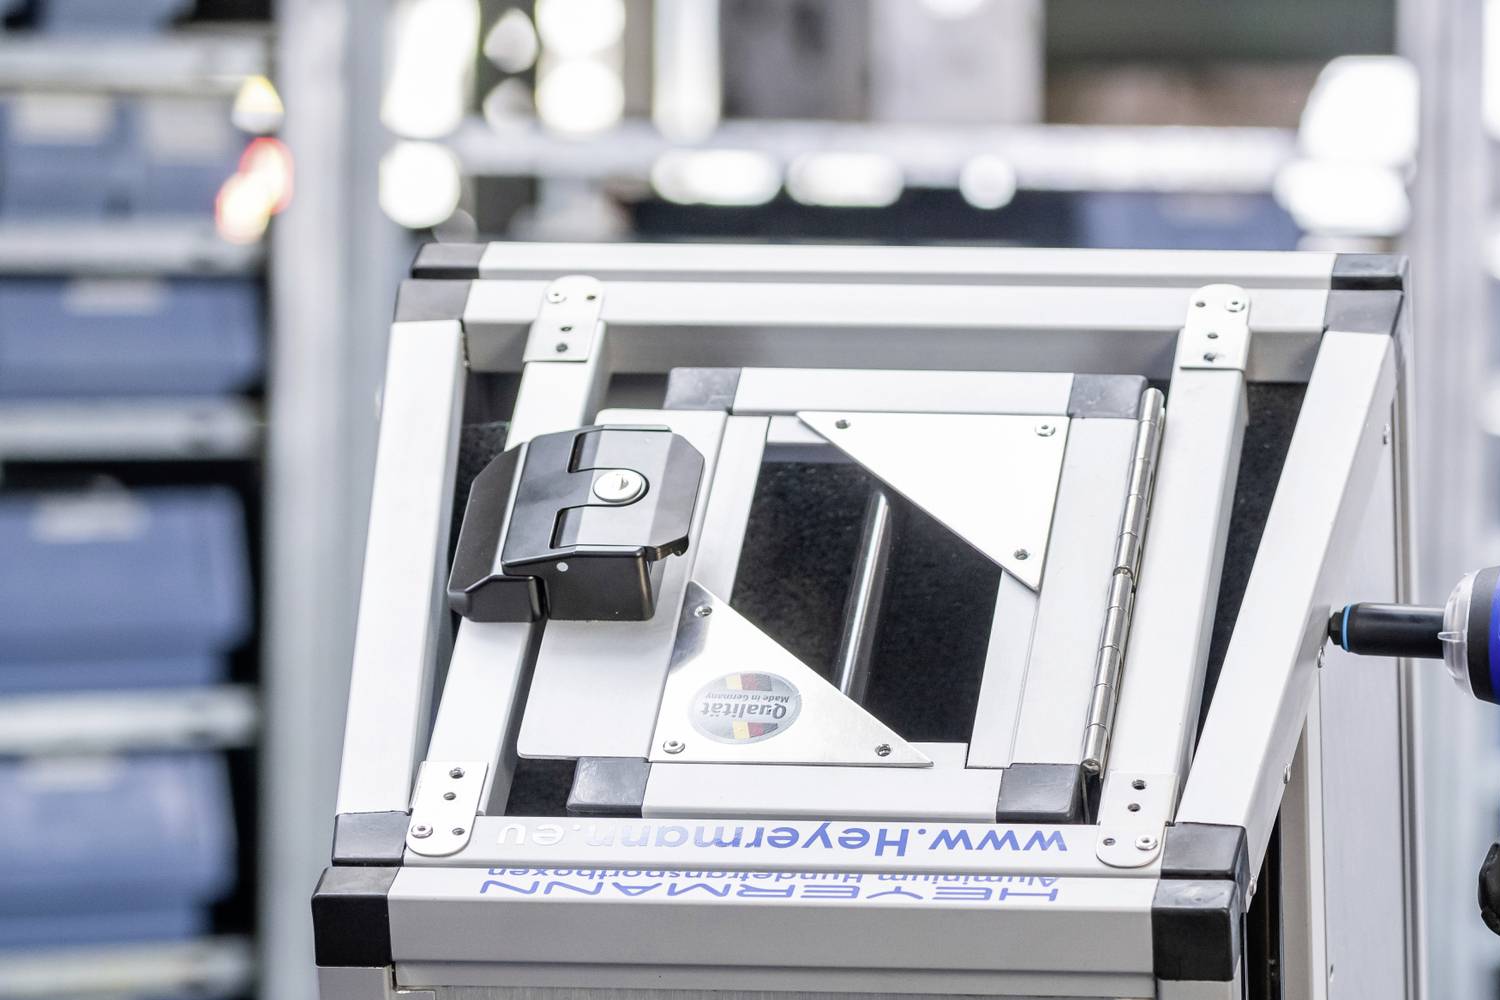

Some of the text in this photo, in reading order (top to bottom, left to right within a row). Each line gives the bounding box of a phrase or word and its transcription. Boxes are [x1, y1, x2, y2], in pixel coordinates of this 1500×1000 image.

[762, 695, 790, 704] Made
[701, 702, 787, 720] Qualität
[499, 819, 1068, 857] www.Heyermann.eu
[480, 880, 1059, 902] HEYERMANN
